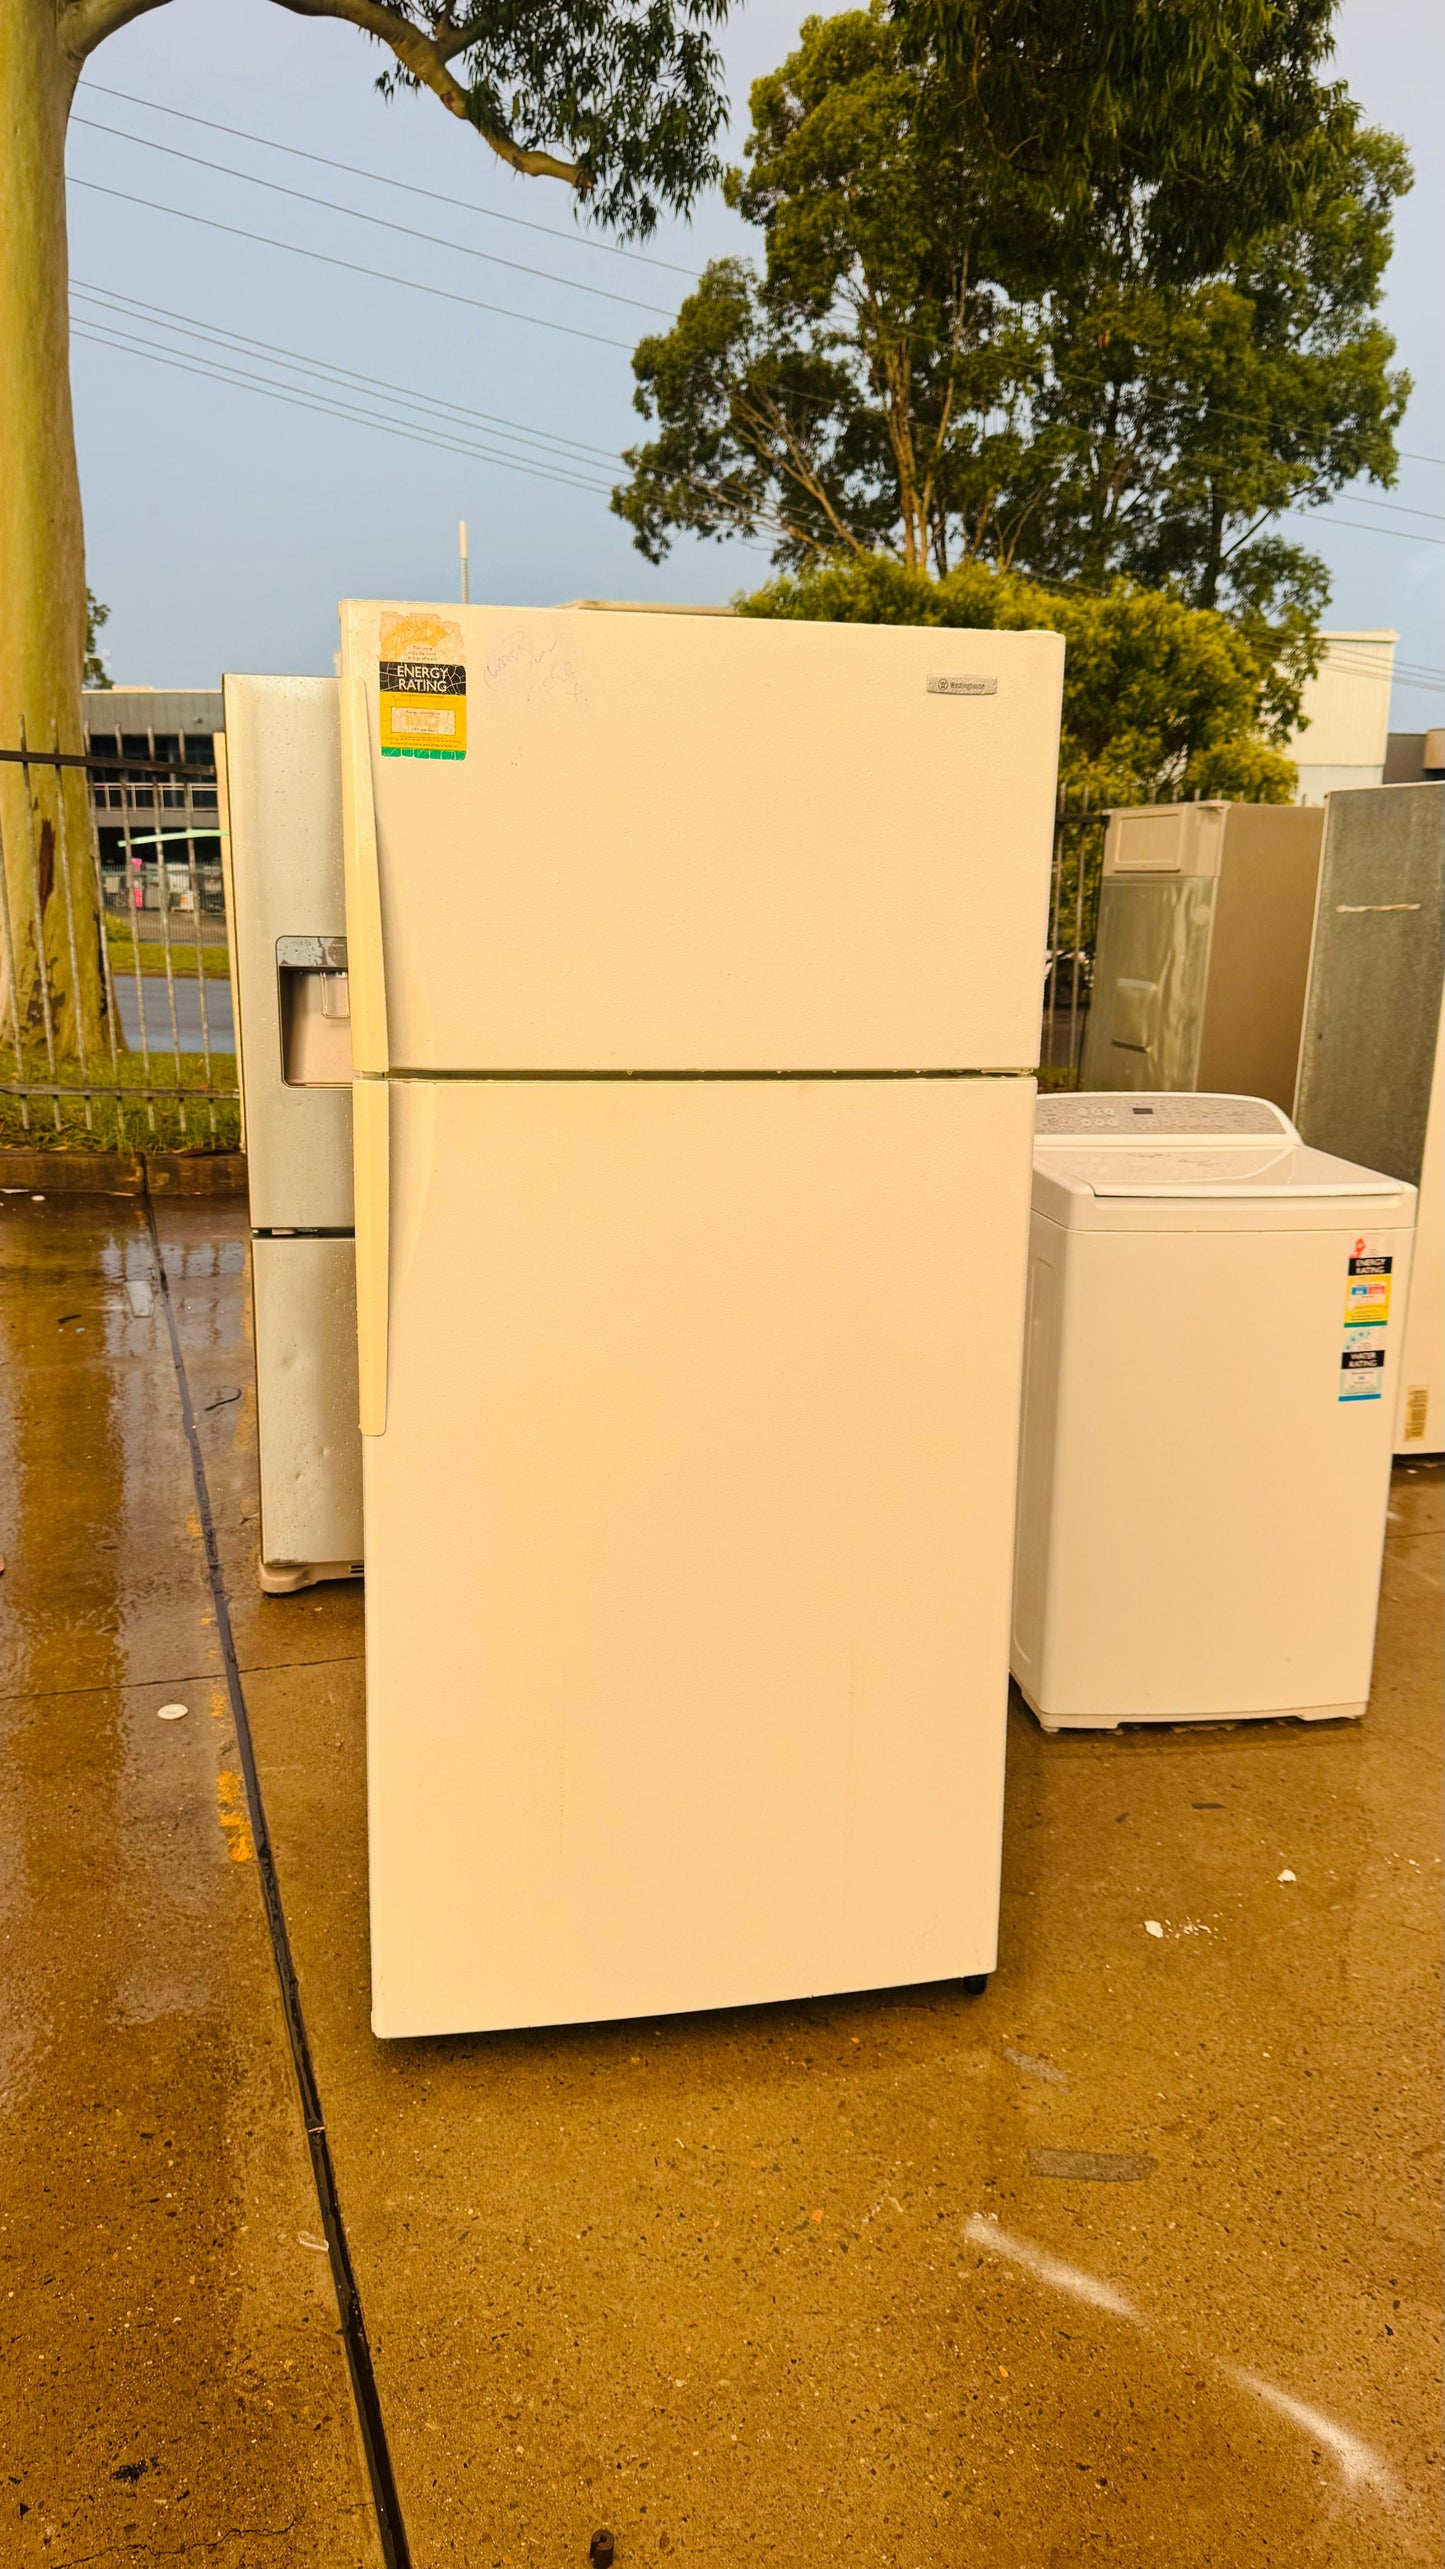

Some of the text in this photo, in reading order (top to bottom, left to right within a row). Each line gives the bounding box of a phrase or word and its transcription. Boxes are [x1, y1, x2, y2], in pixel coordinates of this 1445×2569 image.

[397, 665, 448, 679] ENERGY
[398, 678, 447, 692] RATING
[1355, 1258, 1386, 1267] ENERGY
